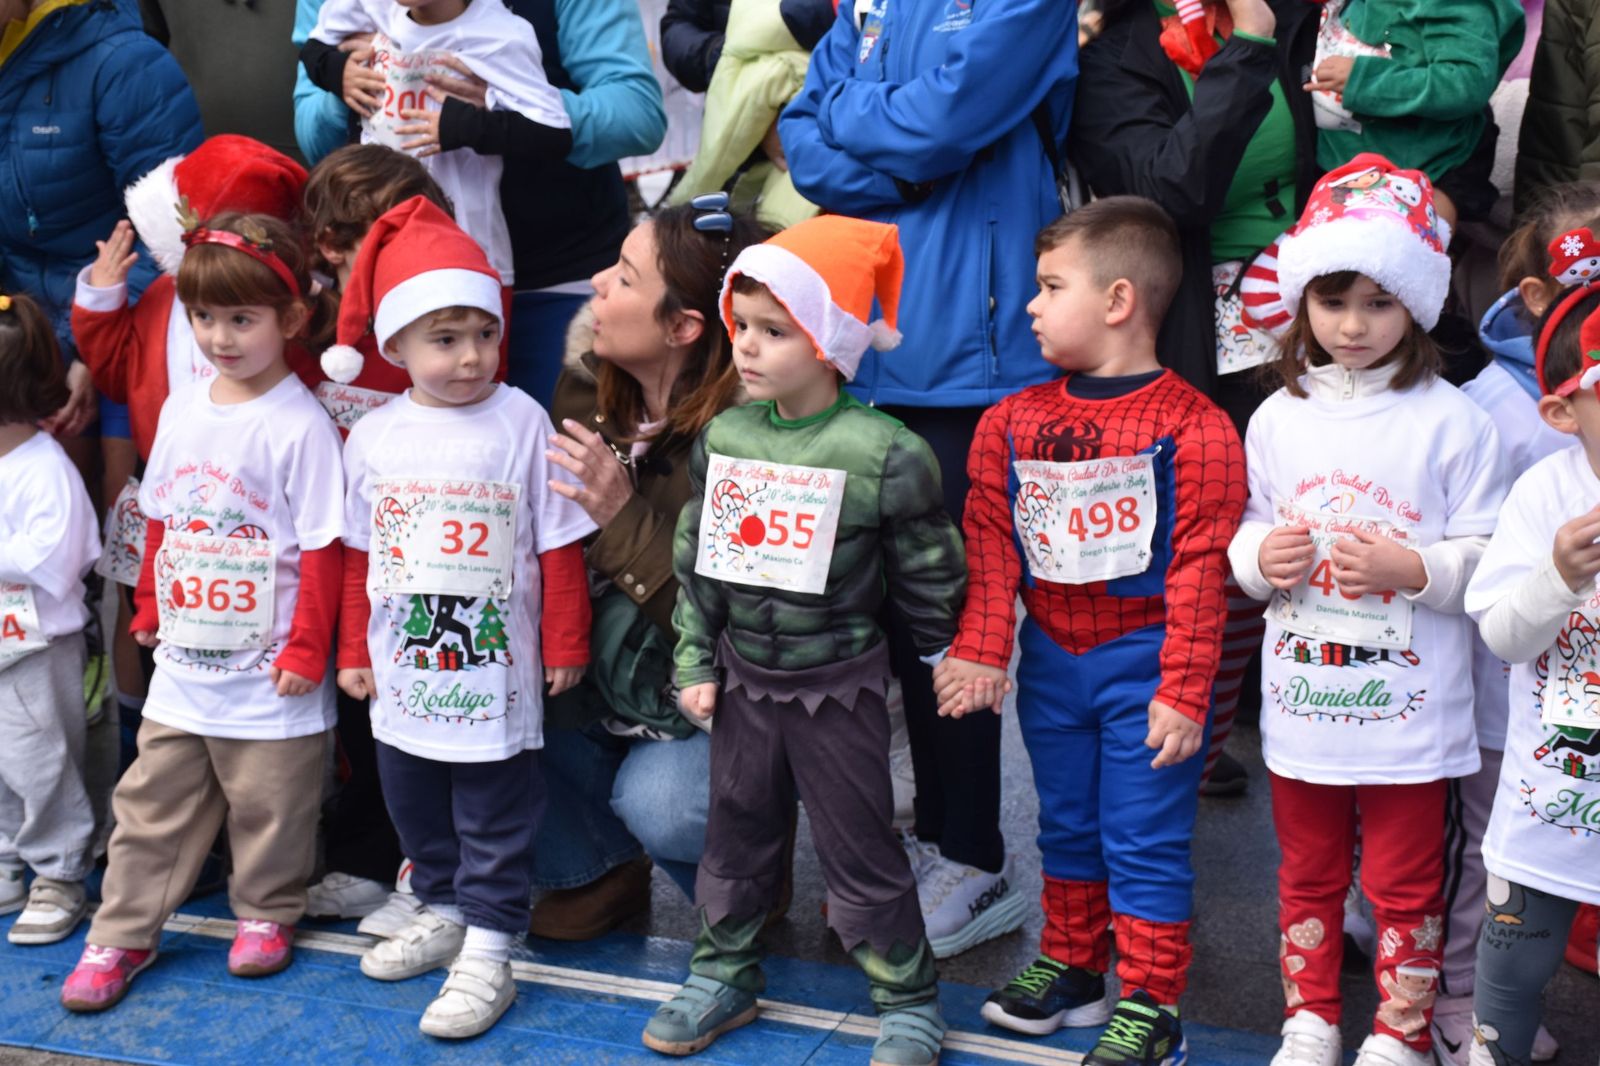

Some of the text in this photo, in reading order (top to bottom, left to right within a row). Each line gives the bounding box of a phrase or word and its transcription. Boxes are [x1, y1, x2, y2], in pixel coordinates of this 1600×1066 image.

[781, 469, 815, 487] Ciudad
[813, 472, 832, 490] De
[1123, 474, 1149, 492] Baby
[1330, 468, 1373, 495] Ciudad
[1372, 485, 1394, 510] De
[1396, 500, 1424, 523] Ceuta
[766, 509, 816, 550] 55
[1067, 496, 1142, 543] 498
[440, 520, 490, 558] 32
[1079, 546, 1103, 559] Diego
[185, 576, 257, 613] 363
[1315, 604, 1389, 622] Daniella Mariscal
[407, 680, 495, 715] Rodrigo
[1283, 675, 1393, 708] Daniella
[968, 875, 1010, 921] HOKA
